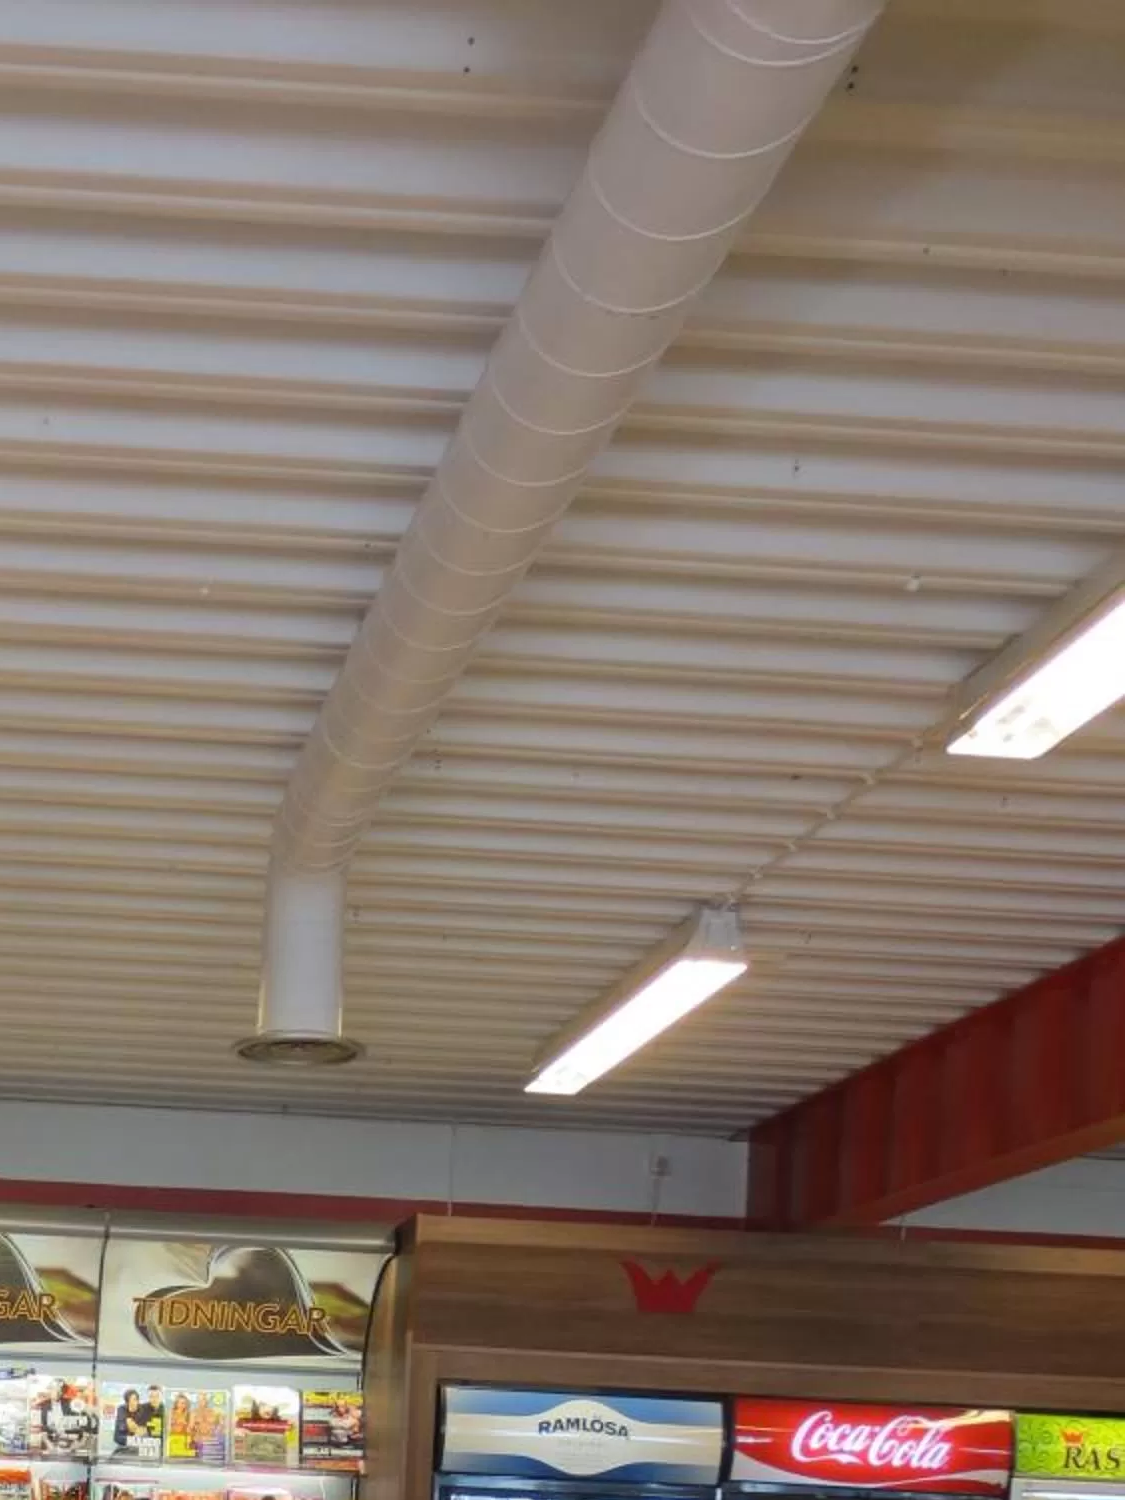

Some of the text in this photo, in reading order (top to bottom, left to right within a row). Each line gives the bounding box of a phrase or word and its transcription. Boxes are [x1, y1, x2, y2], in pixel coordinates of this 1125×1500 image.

[133, 1297, 331, 1335] TIDNINGAR
[538, 1413, 629, 1438] RAMLÖSA
[790, 1409, 953, 1470] Coca-Cola
